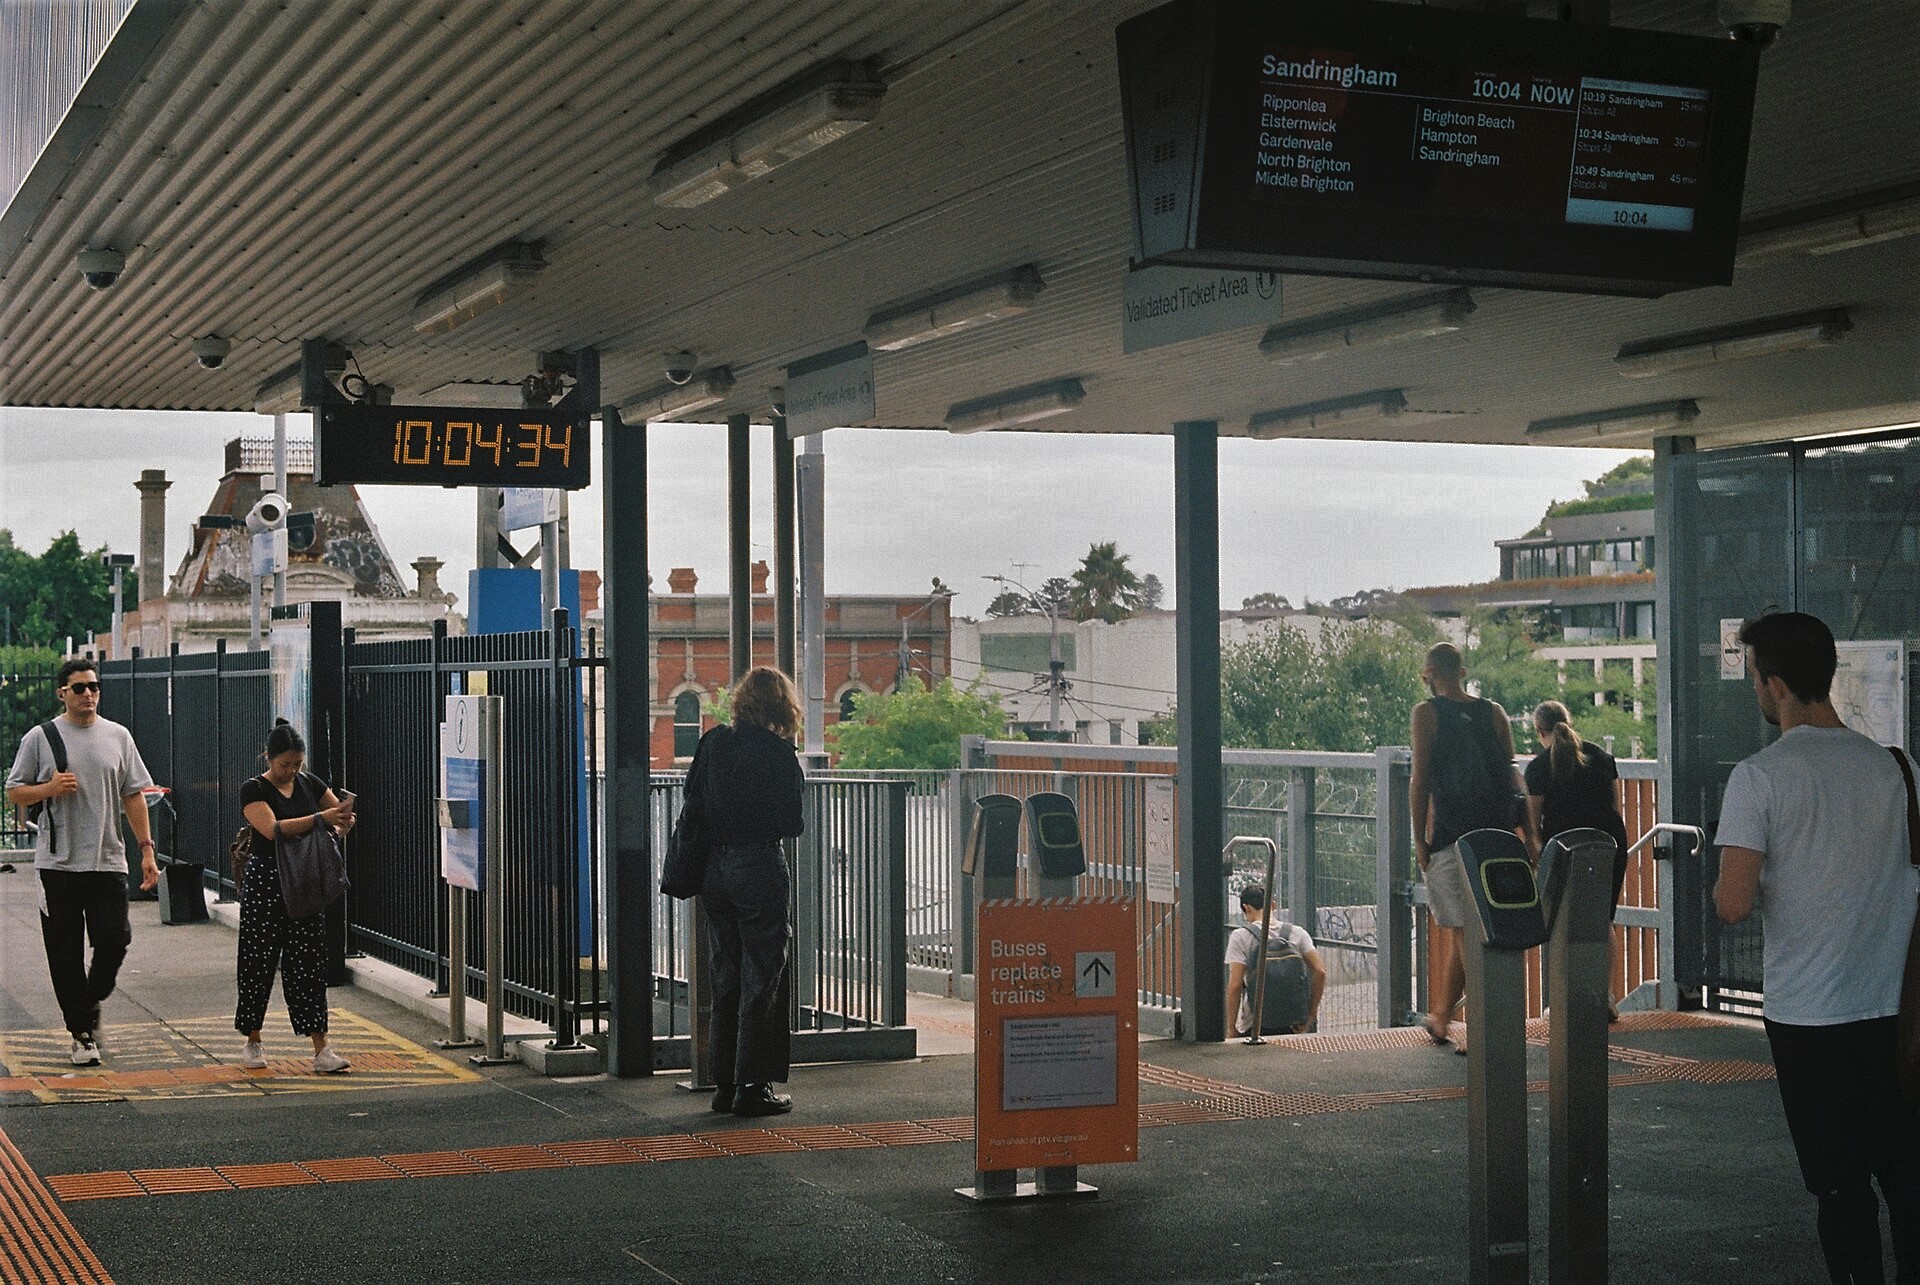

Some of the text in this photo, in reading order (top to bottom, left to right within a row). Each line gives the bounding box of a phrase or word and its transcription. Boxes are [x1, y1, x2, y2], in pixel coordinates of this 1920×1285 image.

[1262, 54, 1398, 88] Sandringham
[1472, 78, 1521, 100] 10:04
[1530, 84, 1575, 105] NOW
[1582, 91, 1606, 103] 10:19
[1608, 94, 1663, 109] Sandringham
[1680, 101, 1690, 111] 15
[1263, 93, 1326, 113] Ripponlea
[1261, 112, 1337, 132] Elsternwick
[1423, 107, 1515, 129] Brighton Beach
[1259, 132, 1333, 152] Gardenvale
[1421, 127, 1477, 146] Hampton
[1578, 128, 1602, 139] 10:34
[1604, 130, 1659, 145] Sandringham
[1674, 137, 1685, 147] 30
[1257, 151, 1351, 173] North Brighton
[1419, 145, 1500, 167] Sandringham
[1255, 170, 1354, 193] Middle Brighton
[1574, 165, 1598, 177] 10:49
[1600, 167, 1655, 182] Sandringham
[1670, 173, 1681, 184] 45
[1613, 210, 1648, 225] 10:04
[1127, 277, 1249, 322] Validated Ticket Area
[393, 420, 572, 468] 10:04:34
[991, 939, 1047, 958] Buses
[991, 962, 1062, 985] replace
[991, 985, 1046, 1005] trains
